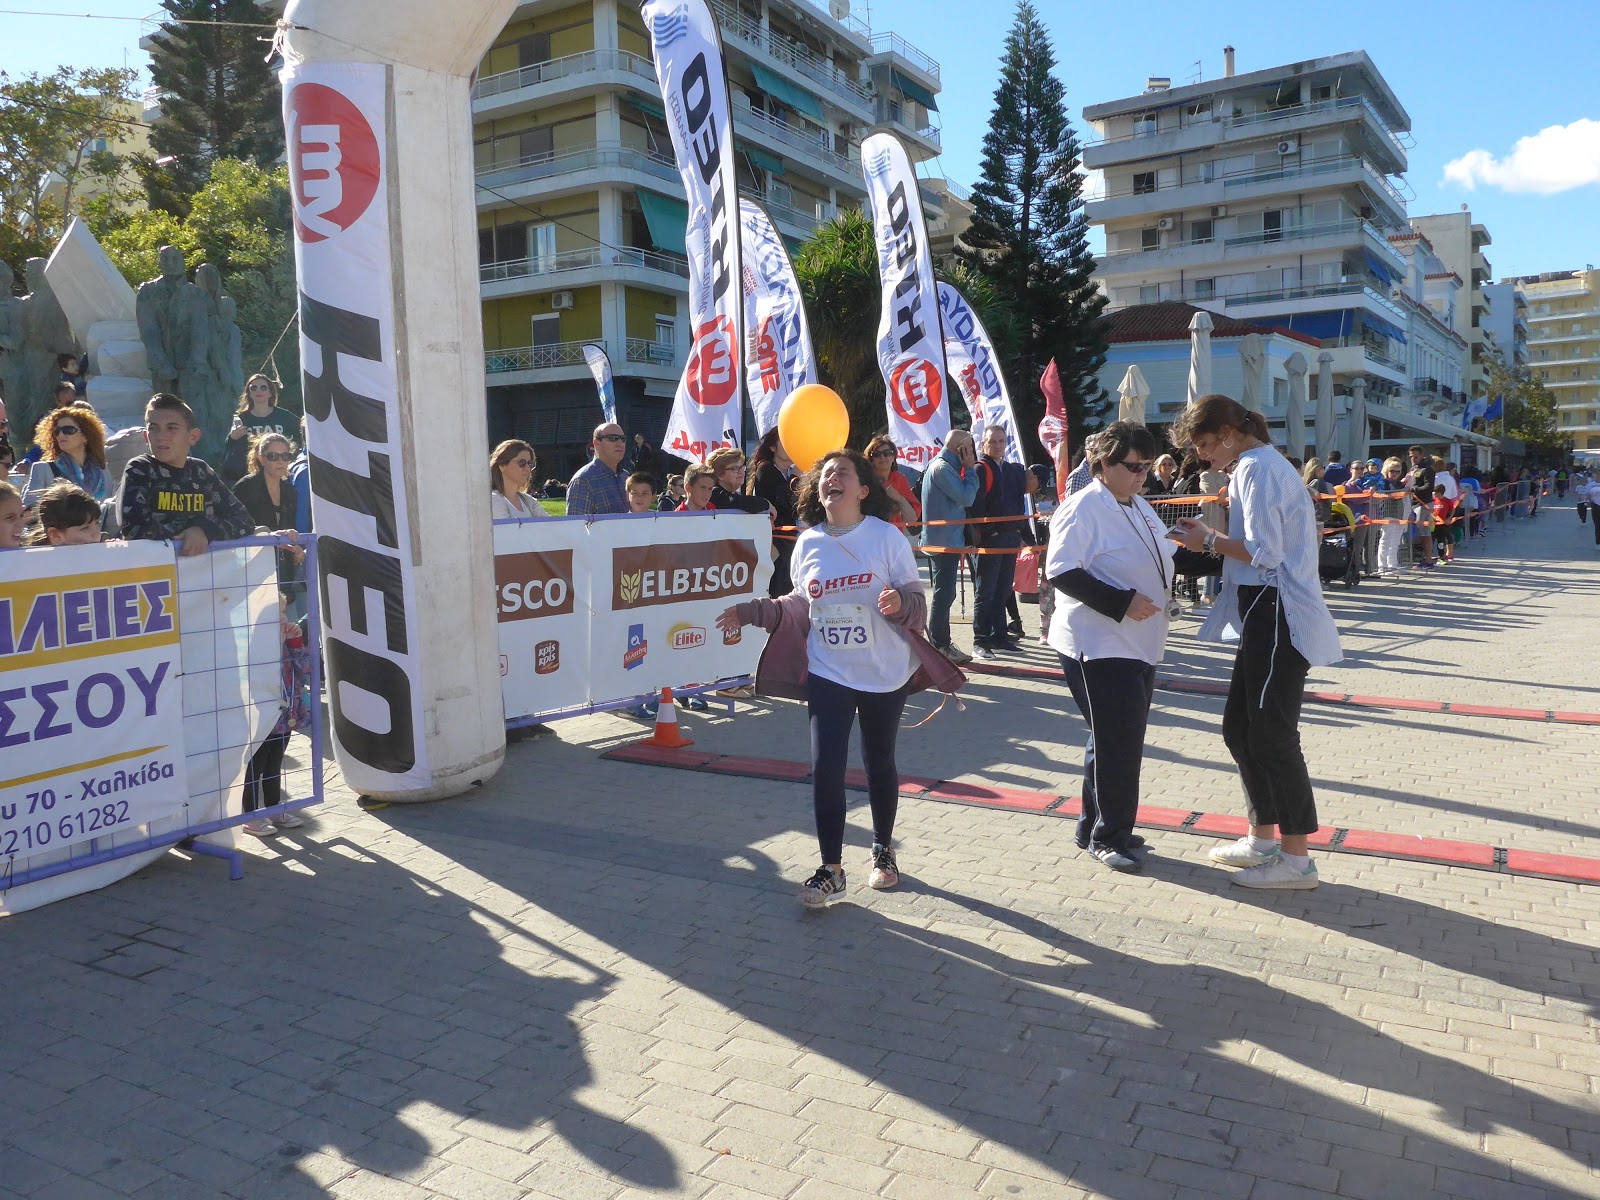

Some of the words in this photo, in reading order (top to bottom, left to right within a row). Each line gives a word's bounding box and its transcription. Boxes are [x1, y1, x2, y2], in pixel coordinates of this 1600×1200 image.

[158, 491, 205, 513] MASTER
[642, 561, 749, 598] ELBISCO
[675, 631, 703, 647] Elite
[819, 625, 868, 645] 1573
[26, 789, 57, 815] 70
[80, 760, 175, 801] Χαλκίδα
[0, 821, 52, 856] 210
[58, 800, 131, 839] 61282
